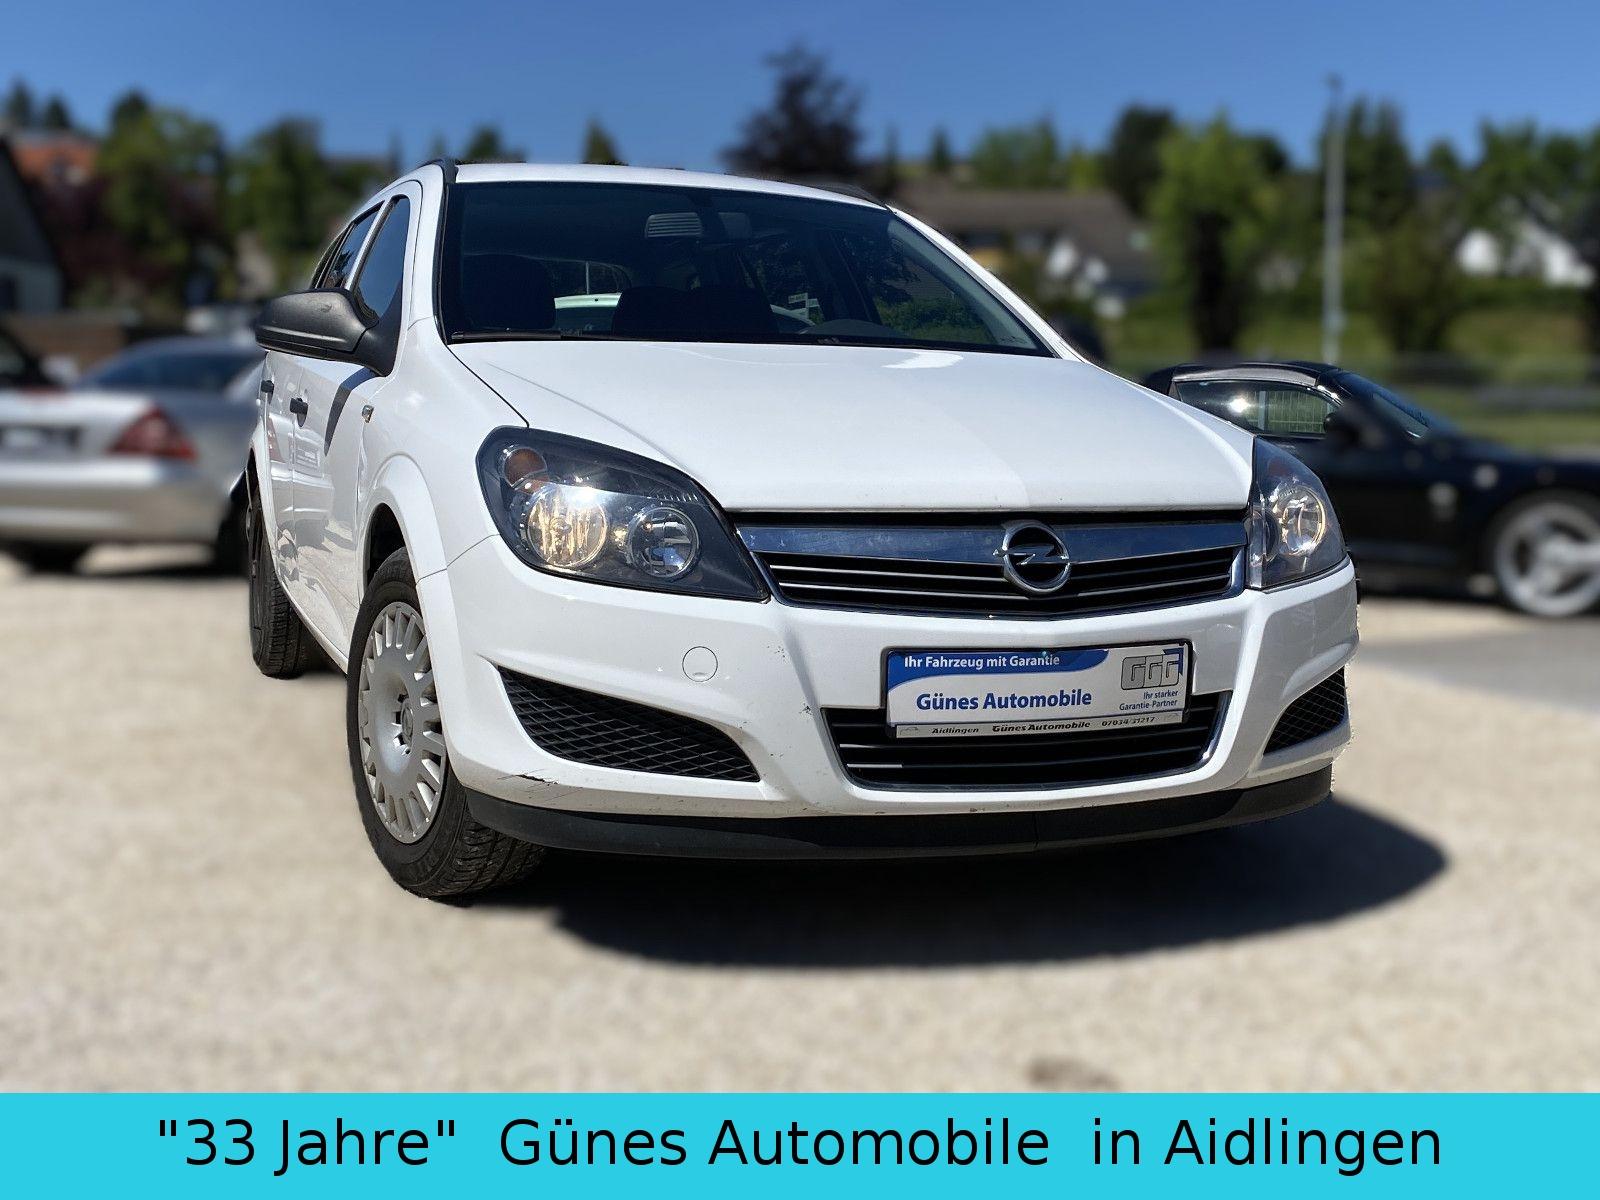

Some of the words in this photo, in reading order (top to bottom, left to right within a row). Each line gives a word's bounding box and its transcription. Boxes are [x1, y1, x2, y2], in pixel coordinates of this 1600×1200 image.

[904, 656, 922, 668] Ihr
[925, 656, 984, 670] Fahrzeug
[986, 655, 1007, 667] mit
[1009, 654, 1060, 667] Garantie
[916, 692, 979, 710] Günes
[983, 689, 1092, 709] Automobile
[1143, 690, 1153, 700] Ihr
[1154, 689, 1179, 699] starker
[931, 726, 979, 734] Aidlingen
[992, 724, 1027, 733] Günes
[1028, 721, 1091, 731] Automobile
